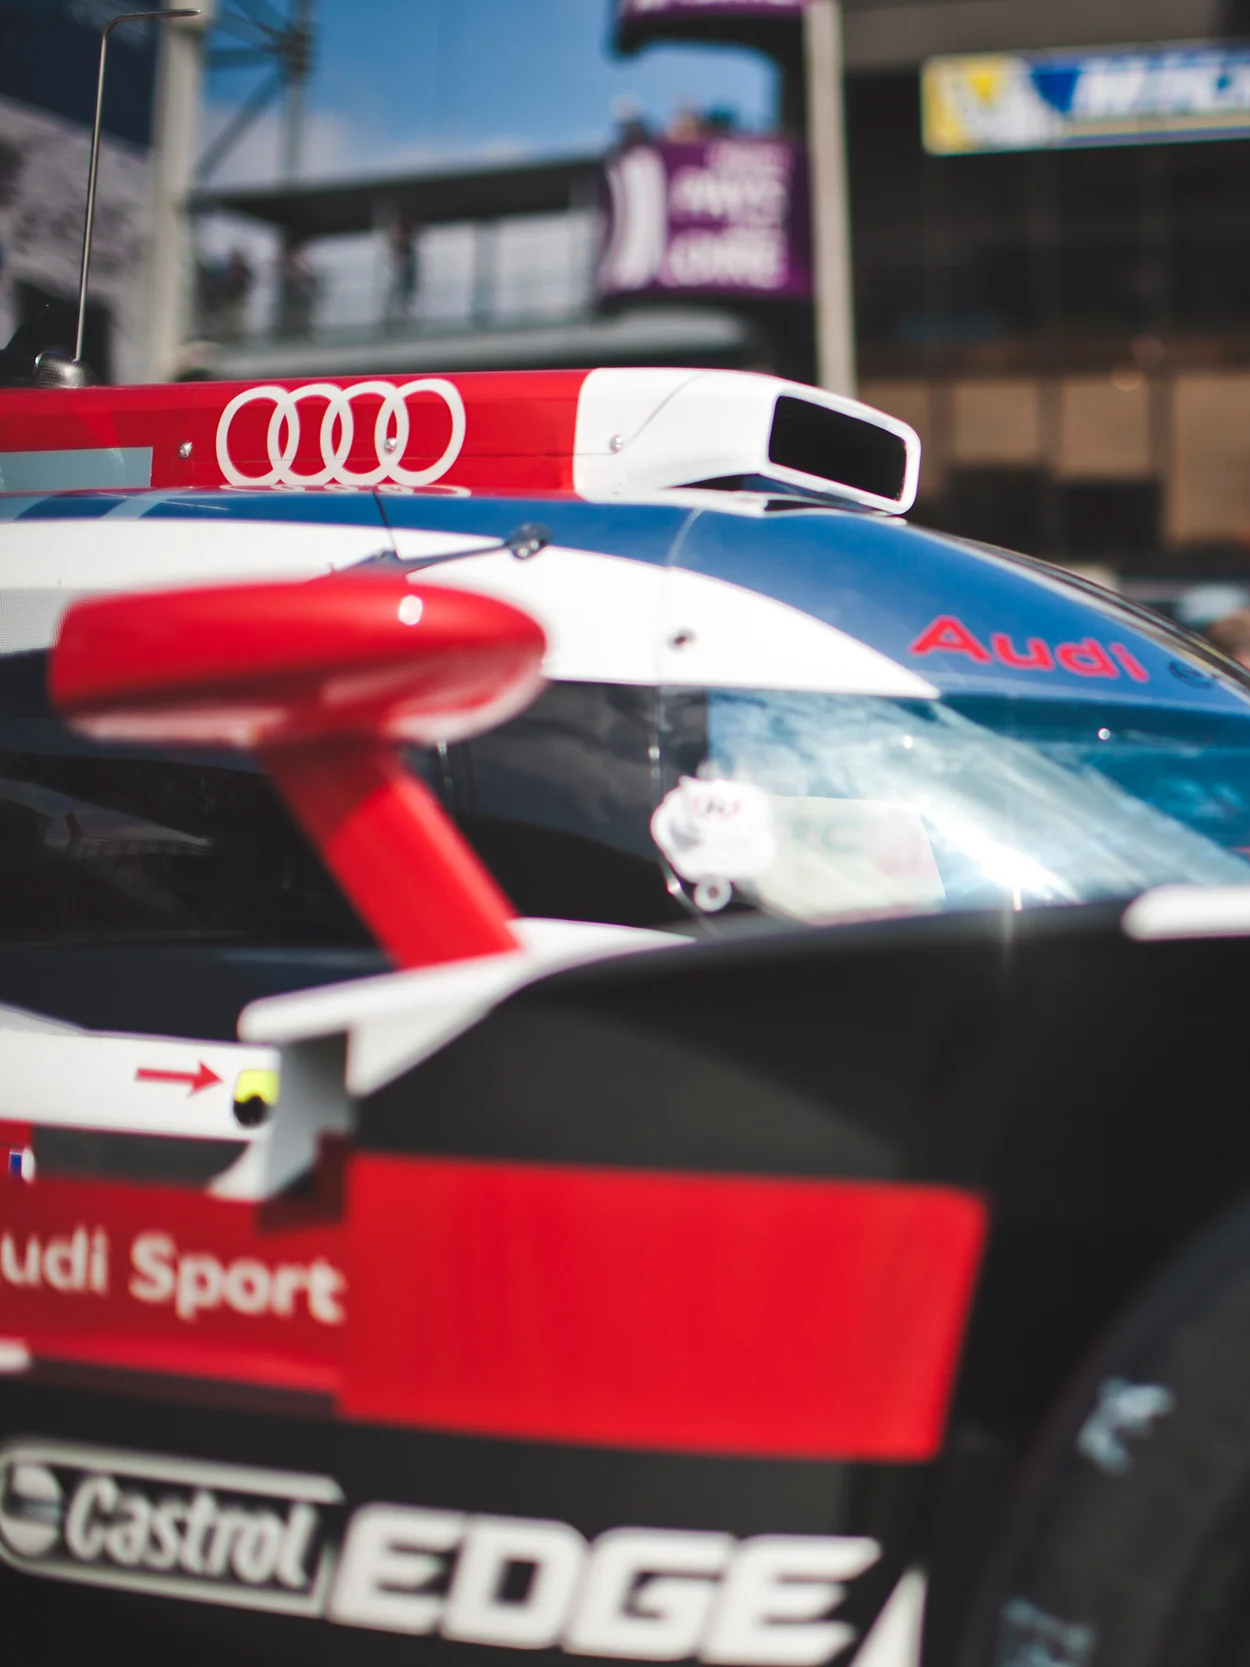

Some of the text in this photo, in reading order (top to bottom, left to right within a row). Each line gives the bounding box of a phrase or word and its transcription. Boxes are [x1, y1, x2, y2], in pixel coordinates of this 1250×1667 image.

[908, 614, 1149, 683] Audi
[0, 1224, 347, 1326] udi Sport
[65, 1472, 318, 1590] Castrol
[324, 1500, 883, 1667] EDGE
